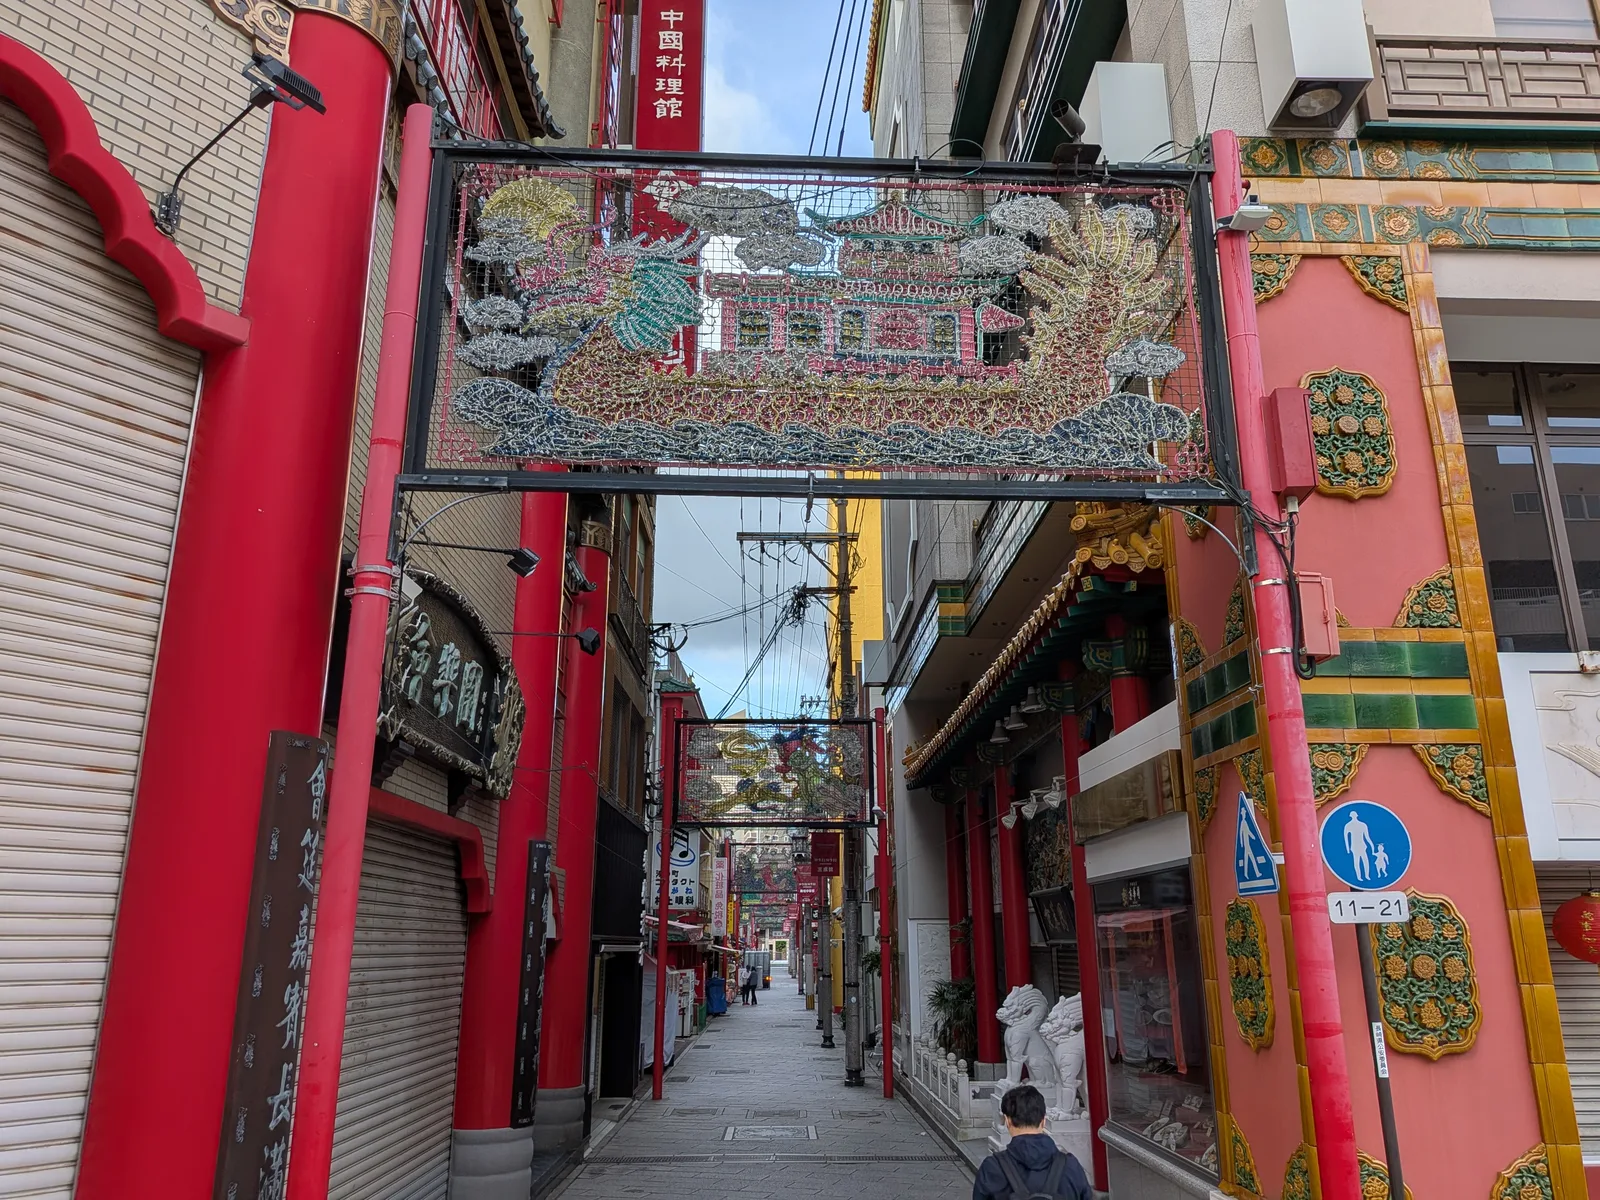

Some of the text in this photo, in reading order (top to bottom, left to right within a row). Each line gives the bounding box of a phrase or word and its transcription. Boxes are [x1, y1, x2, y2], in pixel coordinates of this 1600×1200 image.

[653, 9, 686, 119] 中國料理館
[655, 878, 695, 886] コタクト
[1335, 899, 1402, 916] 11-21
